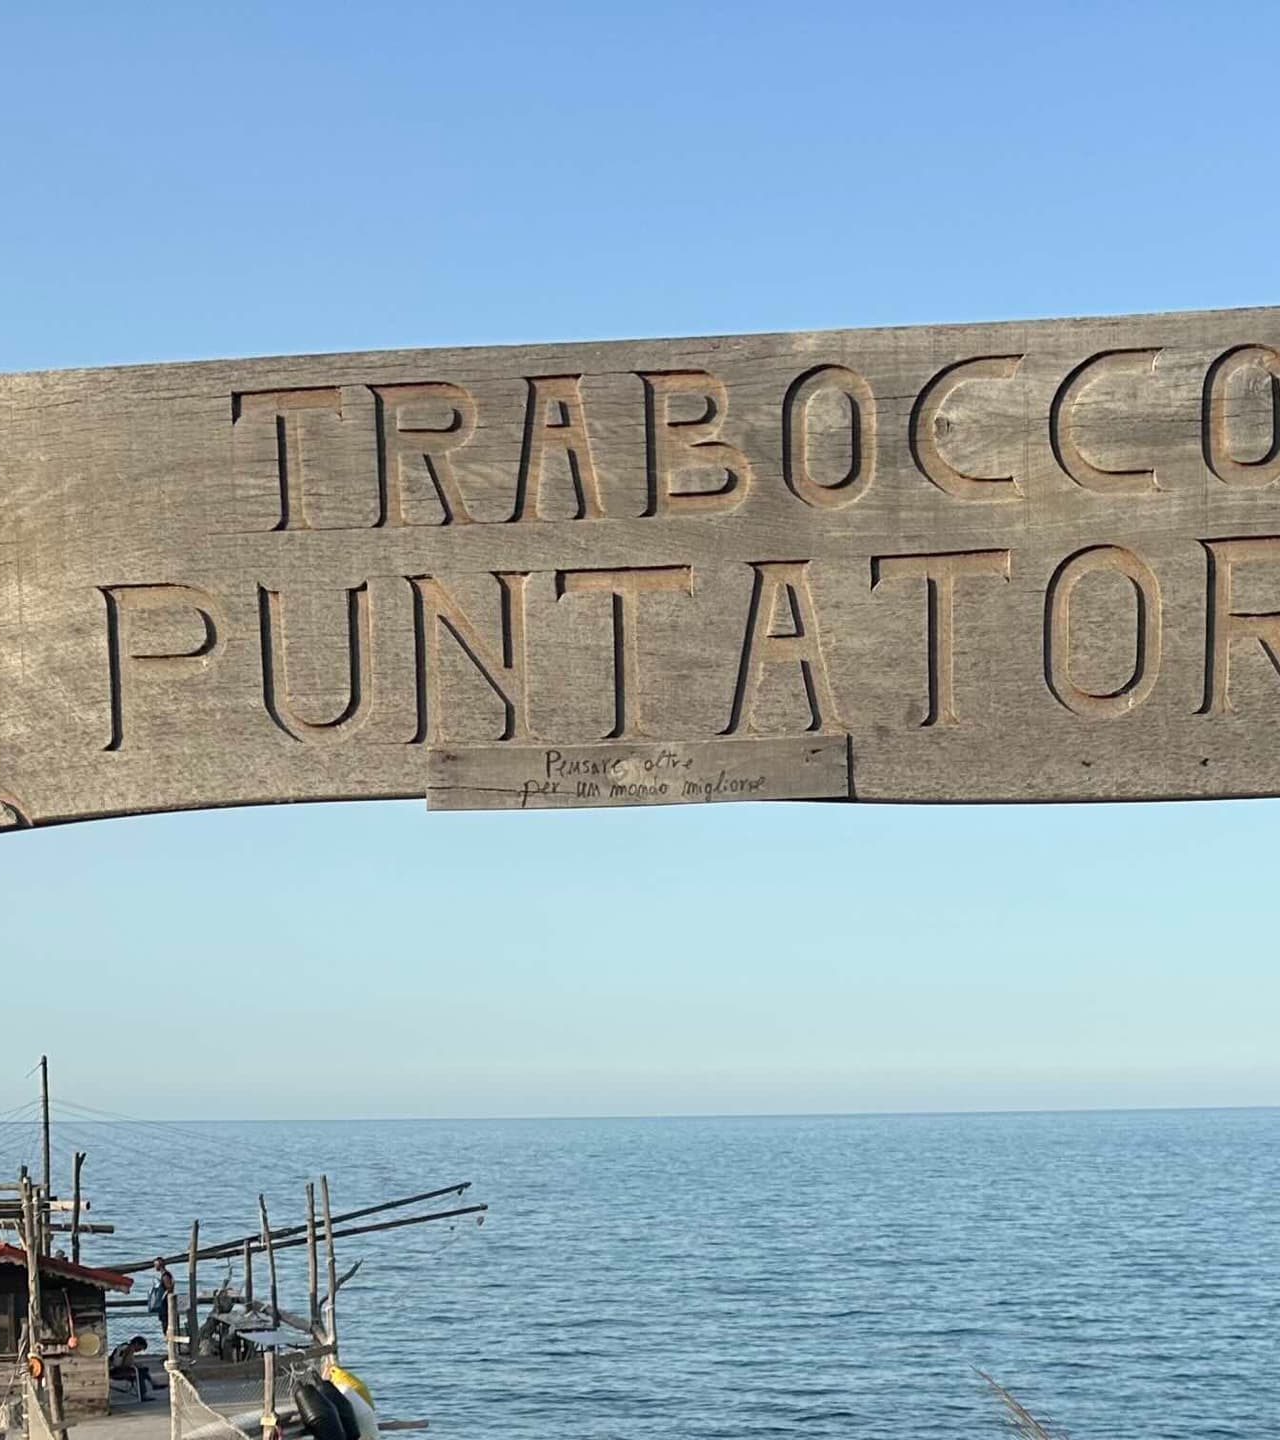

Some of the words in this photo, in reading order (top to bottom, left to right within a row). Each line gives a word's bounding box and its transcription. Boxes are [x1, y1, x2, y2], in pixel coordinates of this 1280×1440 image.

[644, 751, 694, 772] oltre
[521, 780, 560, 808] per
[609, 776, 668, 798] mondo
